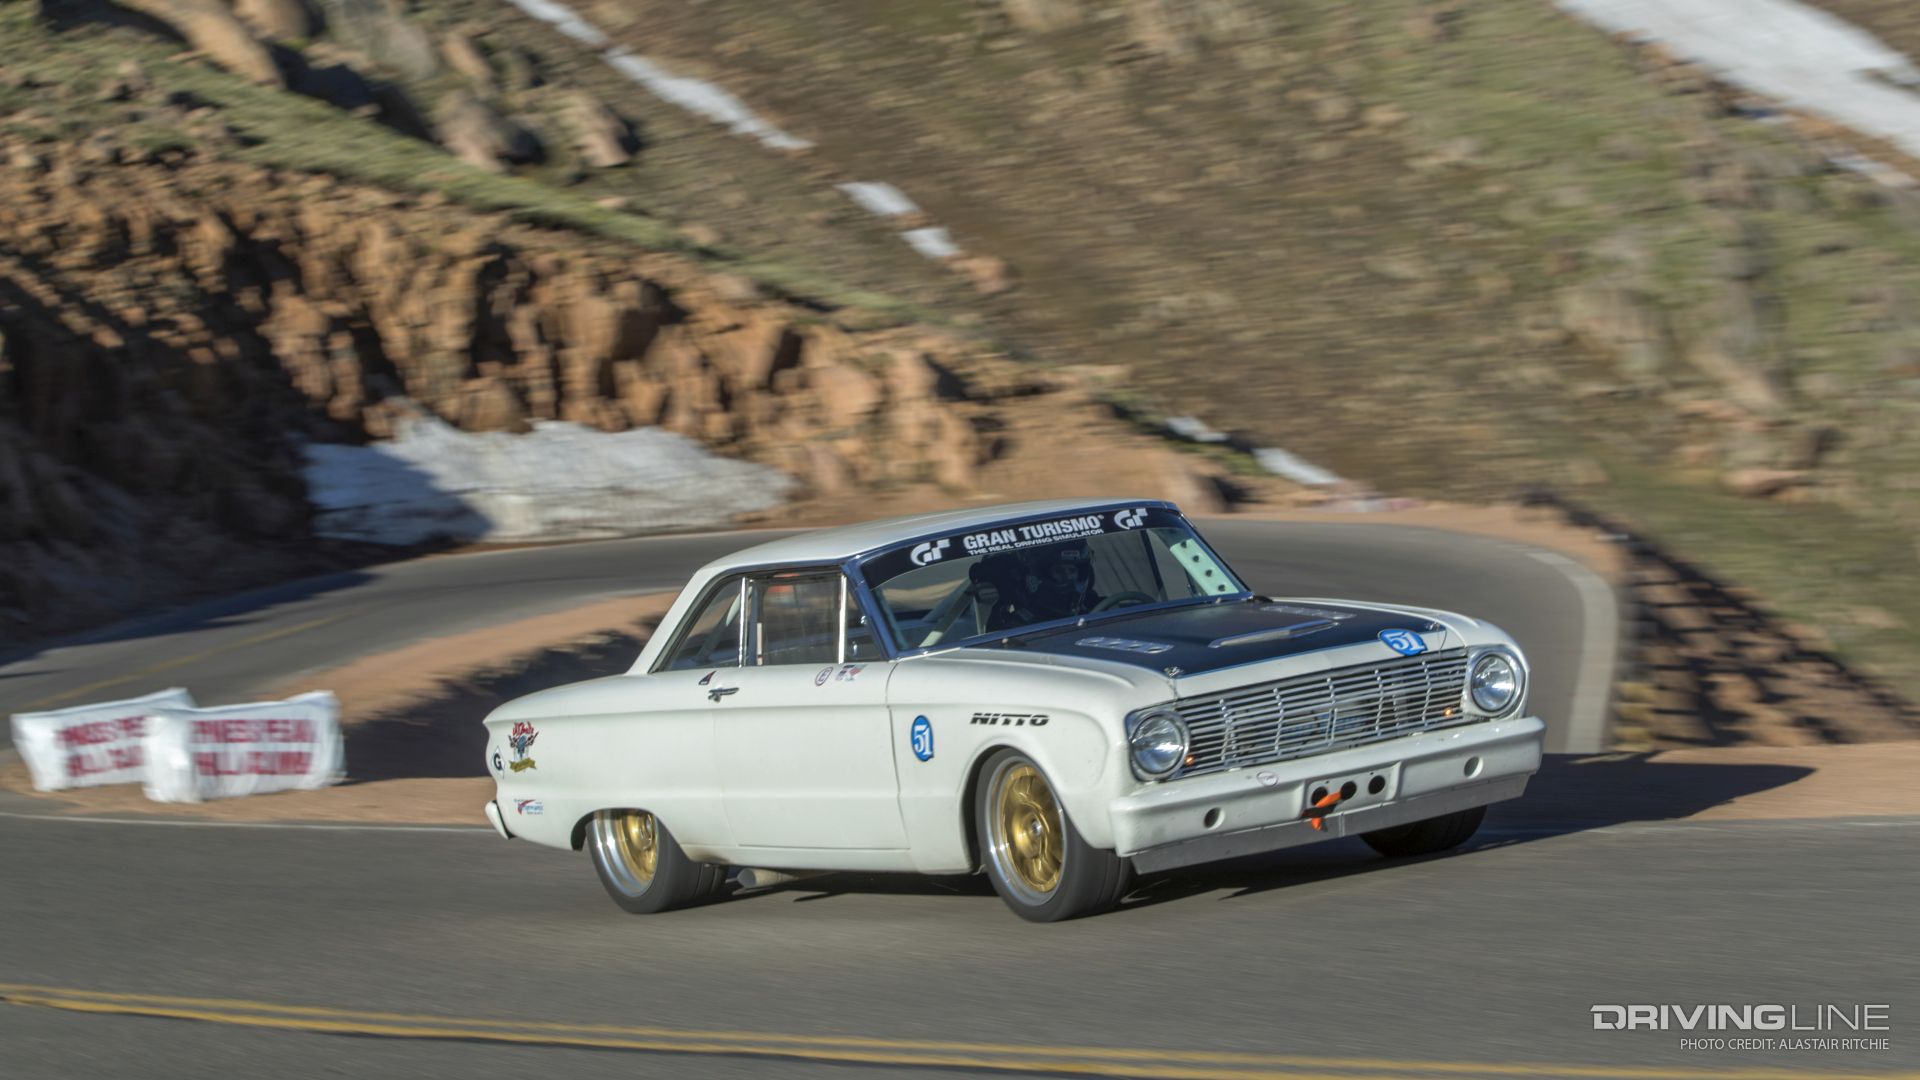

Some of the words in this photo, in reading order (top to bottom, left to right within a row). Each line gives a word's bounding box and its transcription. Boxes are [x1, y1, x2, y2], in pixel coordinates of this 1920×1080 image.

[963, 529, 1017, 550] GRAN
[968, 547, 989, 556] THE
[988, 543, 1014, 553] REAL
[1014, 537, 1053, 549] DRIVING
[1052, 529, 1105, 542] SIMULATOR
[1384, 631, 1425, 651] 51
[970, 713, 1050, 726] NITTO
[914, 725, 932, 755] 51
[493, 753, 504, 771] G
